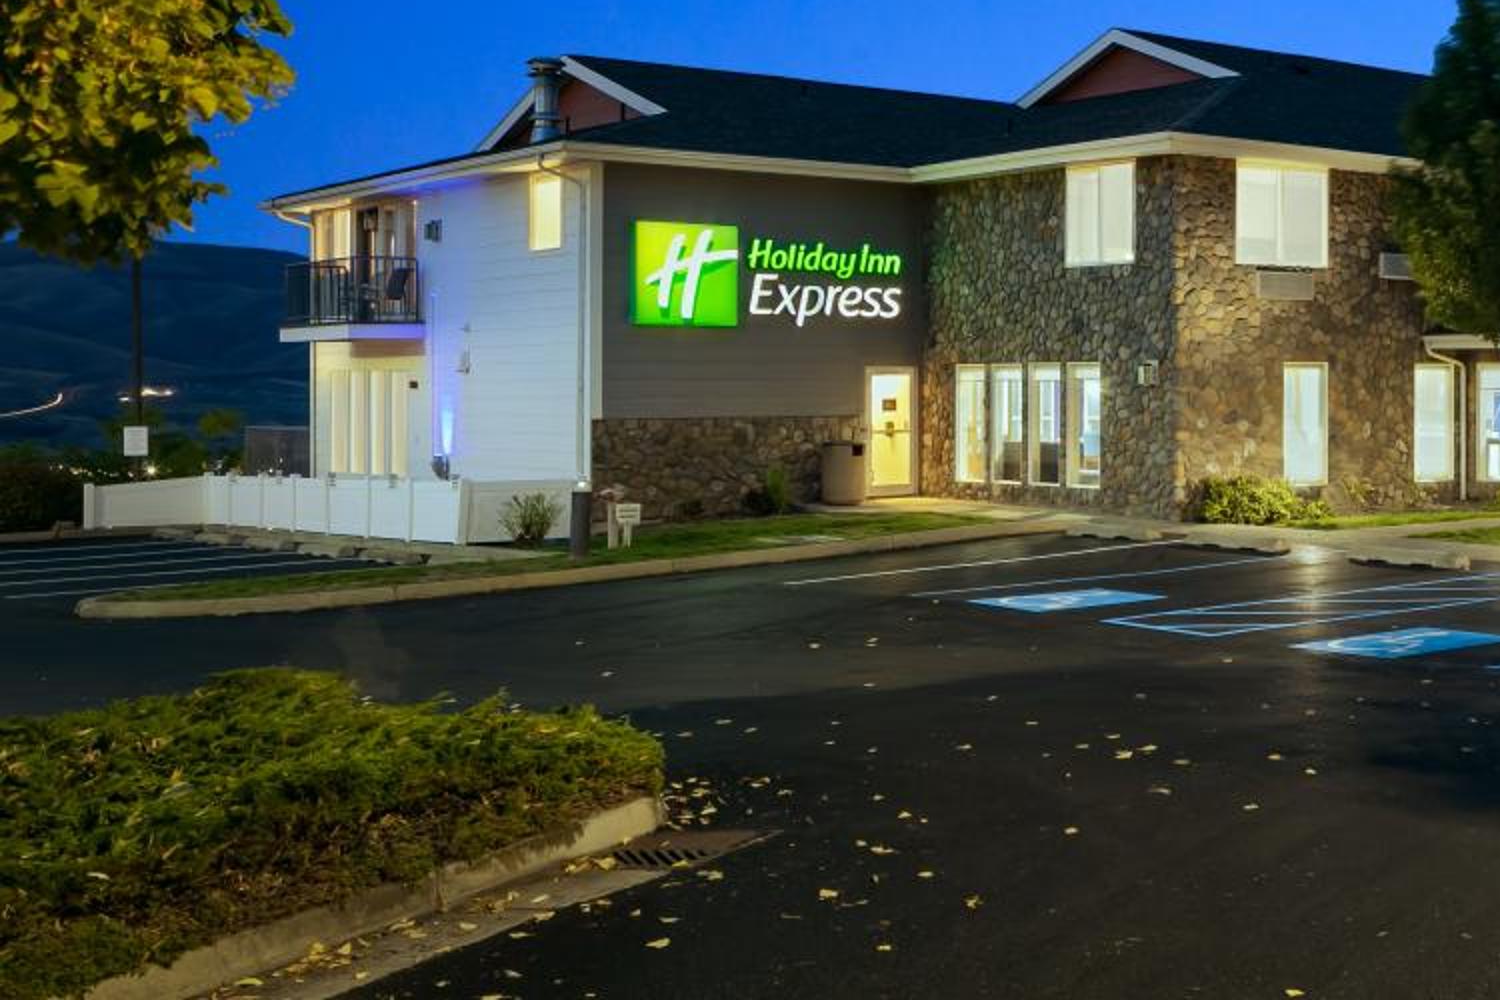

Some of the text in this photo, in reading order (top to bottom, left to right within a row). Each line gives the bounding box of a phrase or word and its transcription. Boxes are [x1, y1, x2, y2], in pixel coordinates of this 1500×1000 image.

[749, 239, 901, 278] Holiday Inn
[749, 273, 902, 327] Express
